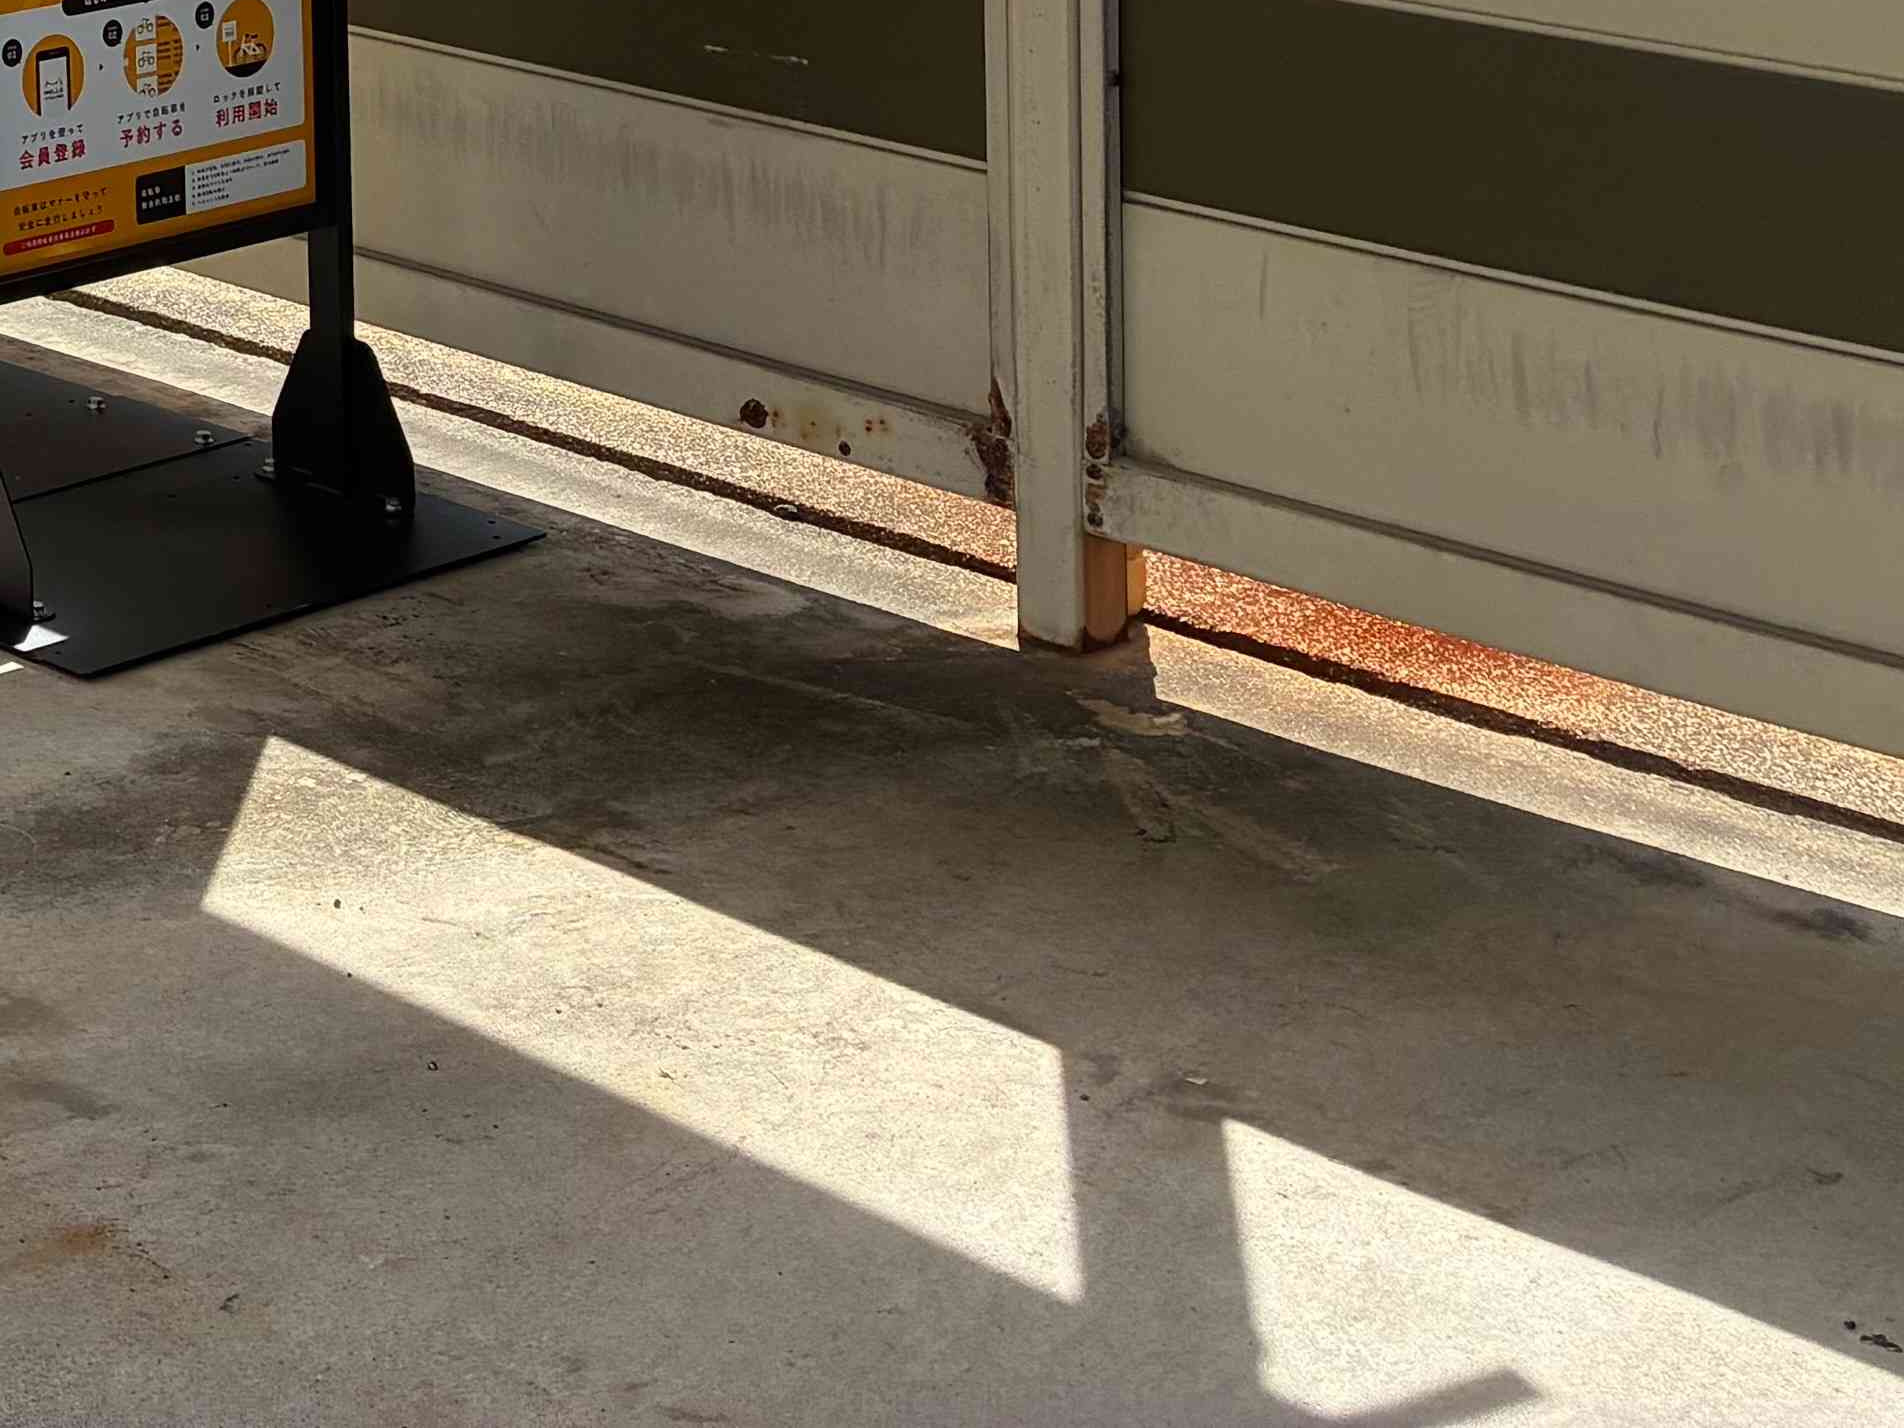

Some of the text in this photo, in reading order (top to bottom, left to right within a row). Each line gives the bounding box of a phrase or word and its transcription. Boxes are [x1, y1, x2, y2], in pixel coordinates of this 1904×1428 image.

[215, 97, 278, 128] 利用開始
[120, 118, 183, 148] 予約する
[19, 138, 86, 170] 会員登録
